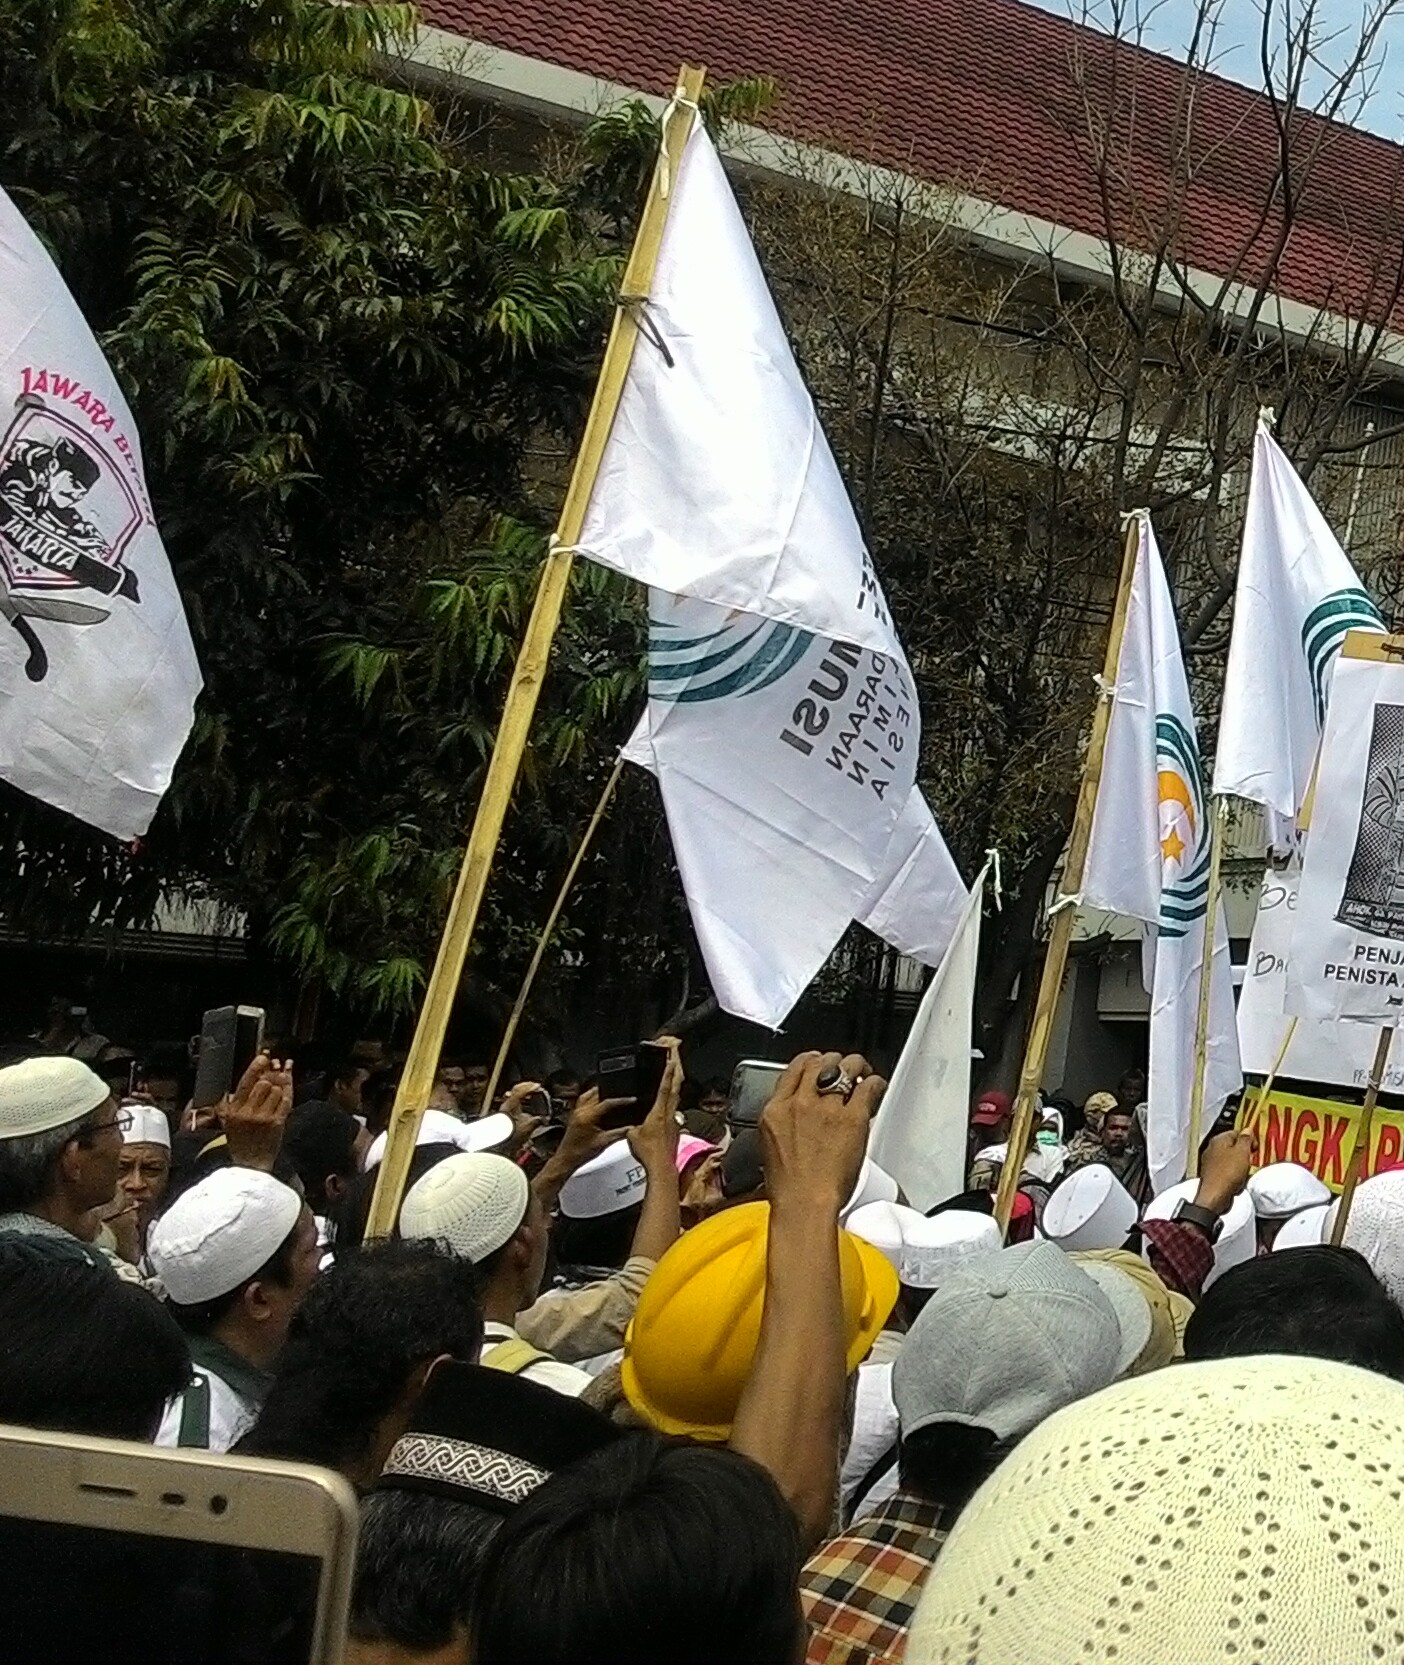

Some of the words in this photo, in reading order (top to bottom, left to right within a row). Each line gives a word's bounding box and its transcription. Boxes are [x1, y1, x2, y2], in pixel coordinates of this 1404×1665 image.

[20, 366, 116, 433] JAWARA
[0, 514, 80, 571] JAKARTA
[1324, 964, 1399, 987] PENISTA
